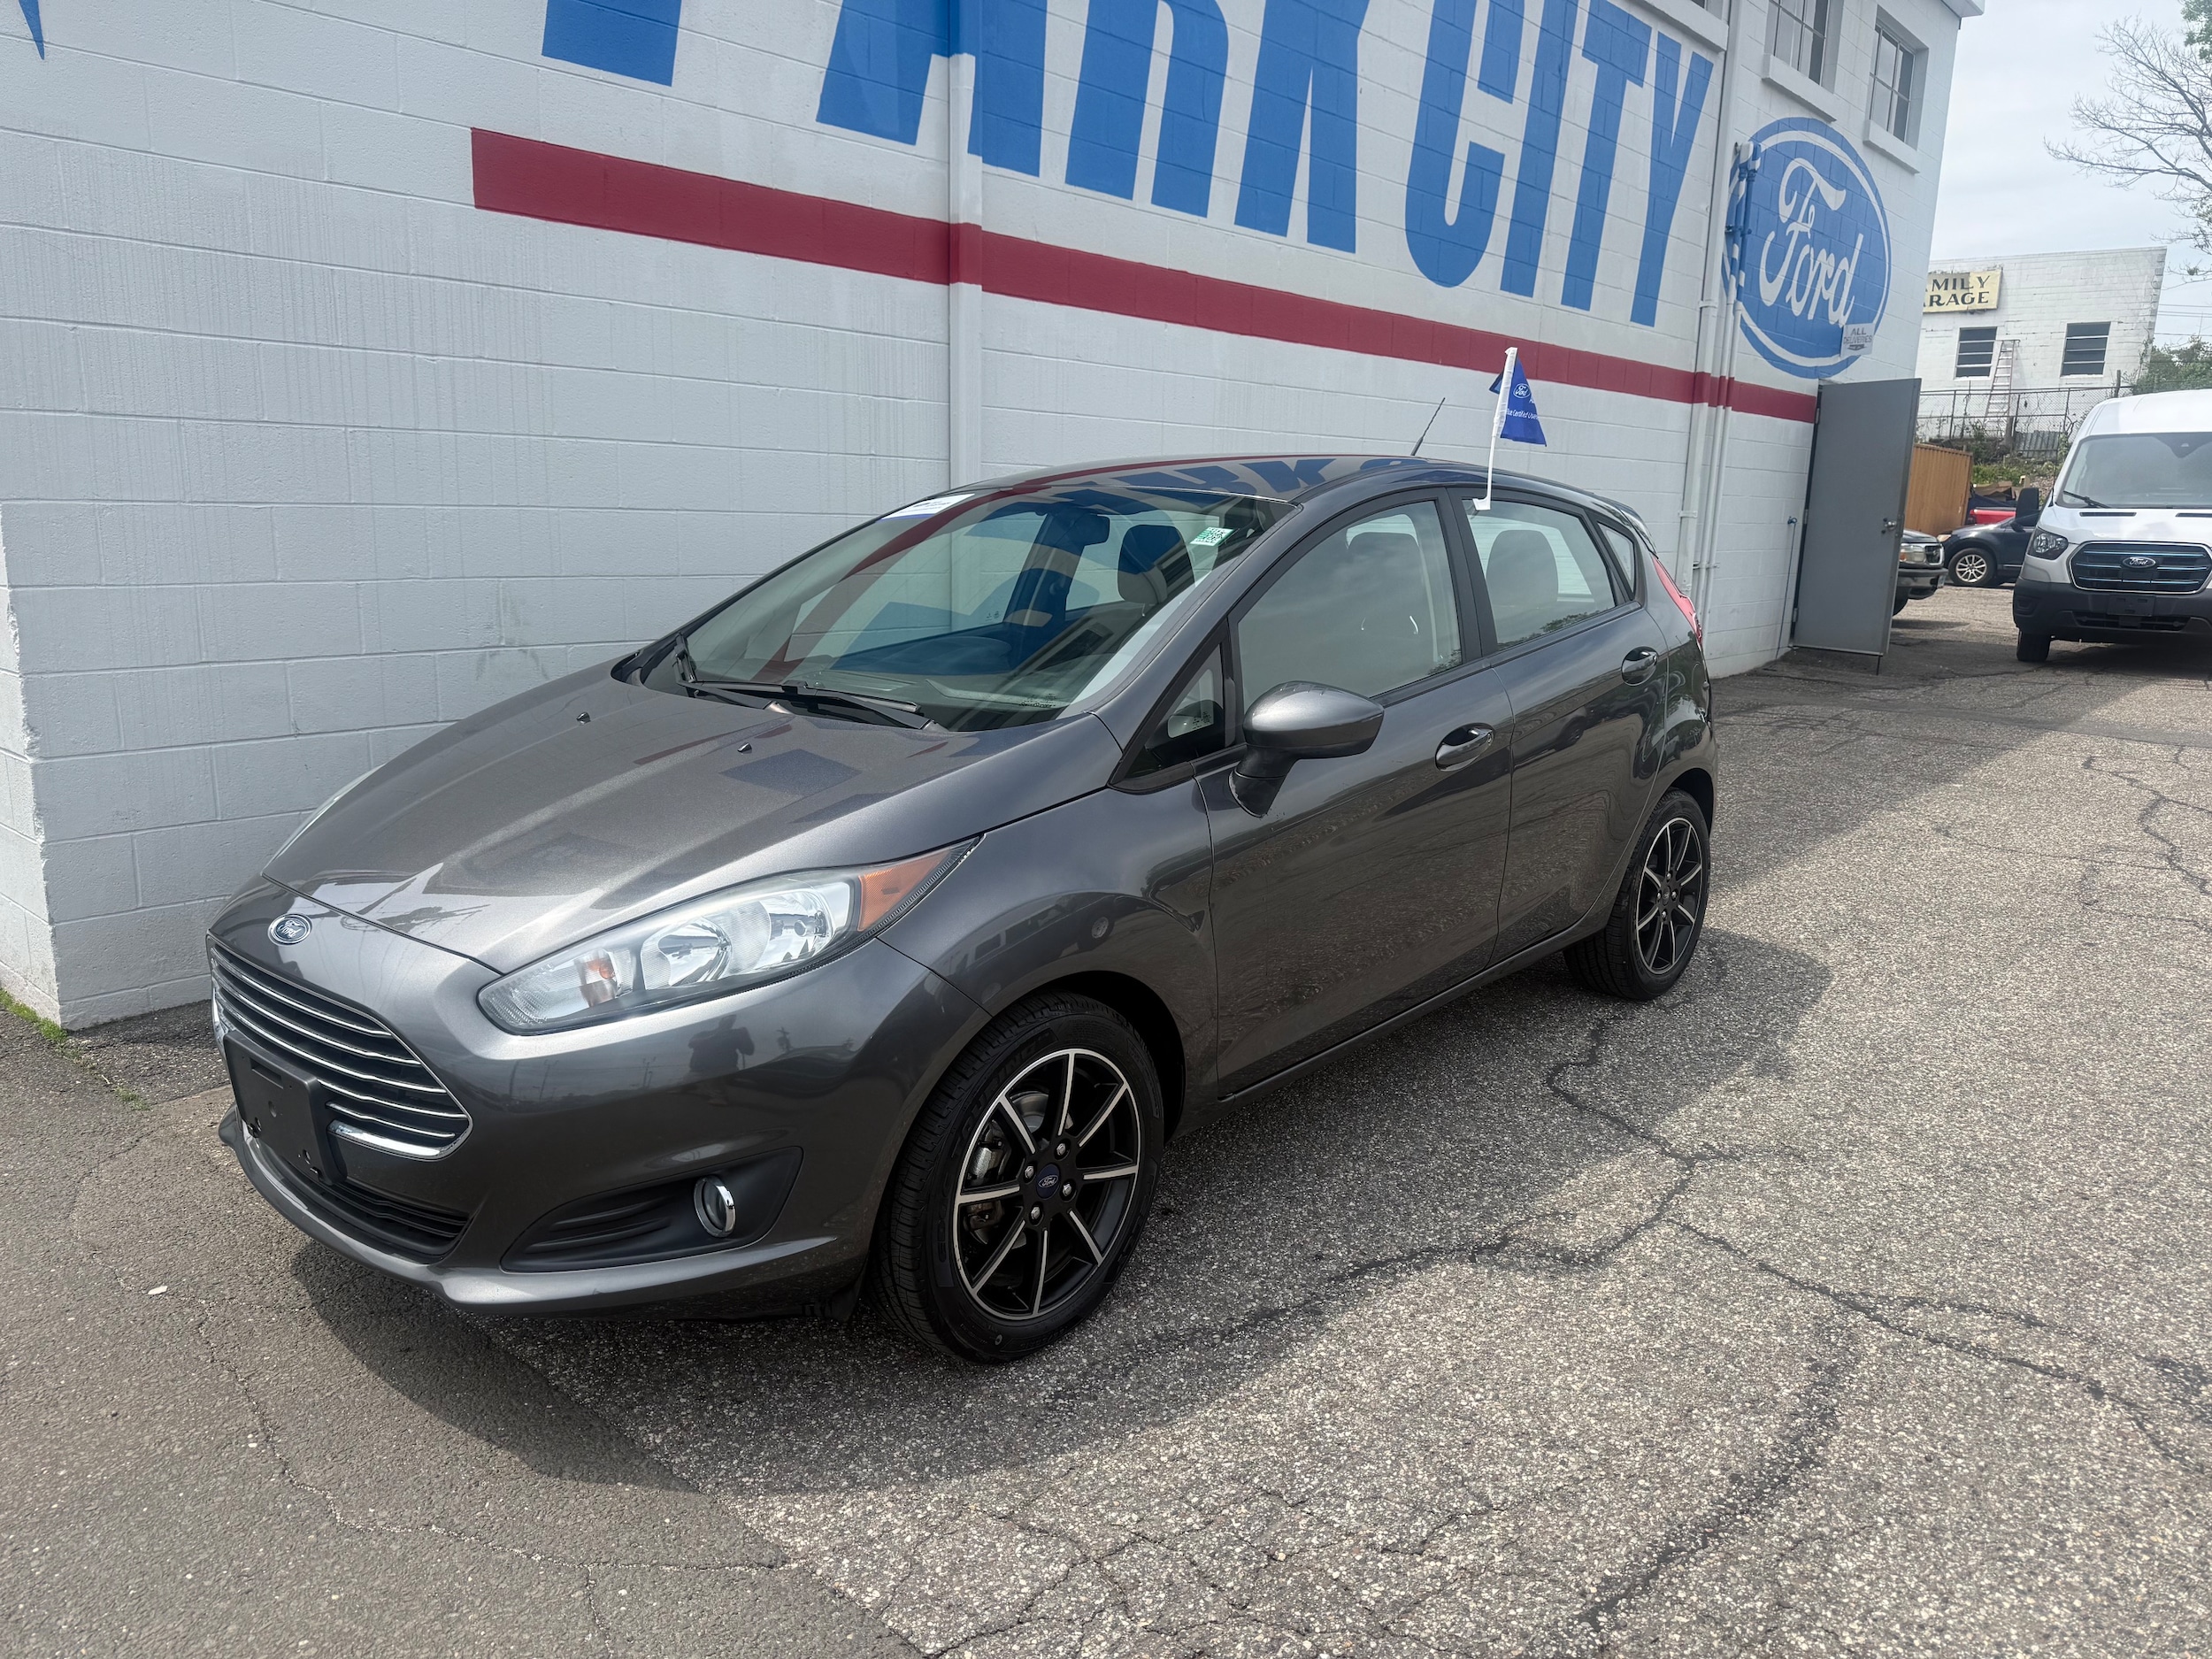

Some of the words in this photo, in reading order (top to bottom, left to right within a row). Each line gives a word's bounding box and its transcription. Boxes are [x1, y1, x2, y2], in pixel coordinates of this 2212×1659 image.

[1405, 0, 1714, 327] CITY
[1759, 157, 1864, 328] Ford
[1925, 275, 1990, 292] MILY
[1923, 291, 1989, 307] RAGE
[1850, 327, 1867, 336] ALL
[277, 919, 303, 939] Ford
